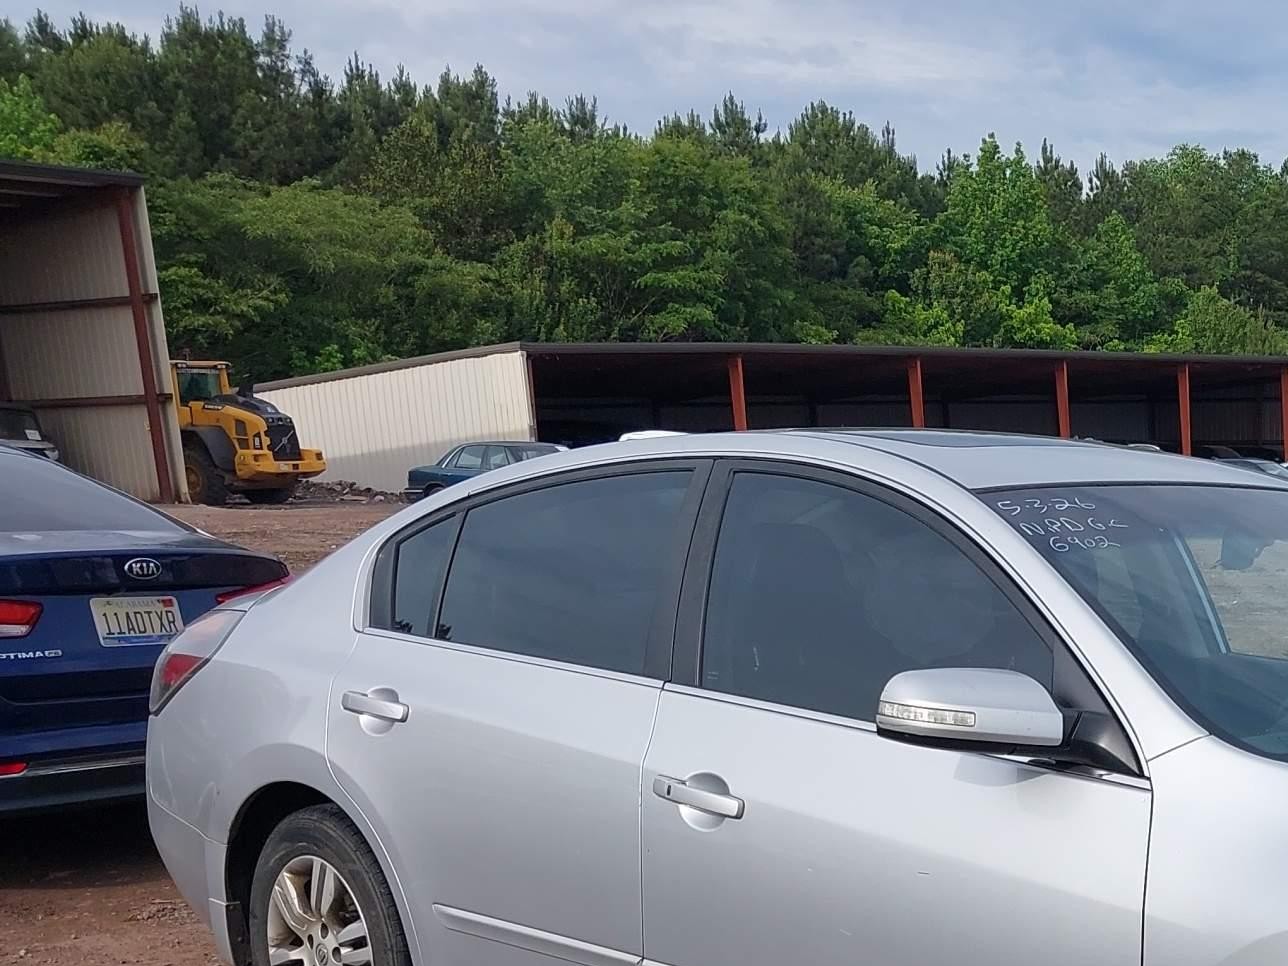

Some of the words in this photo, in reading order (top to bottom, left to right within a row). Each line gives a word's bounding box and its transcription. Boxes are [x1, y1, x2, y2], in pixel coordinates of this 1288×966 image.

[1049, 535, 1121, 552] 6902
[131, 561, 158, 576] KIA
[102, 610, 179, 636] 11ADTXR
